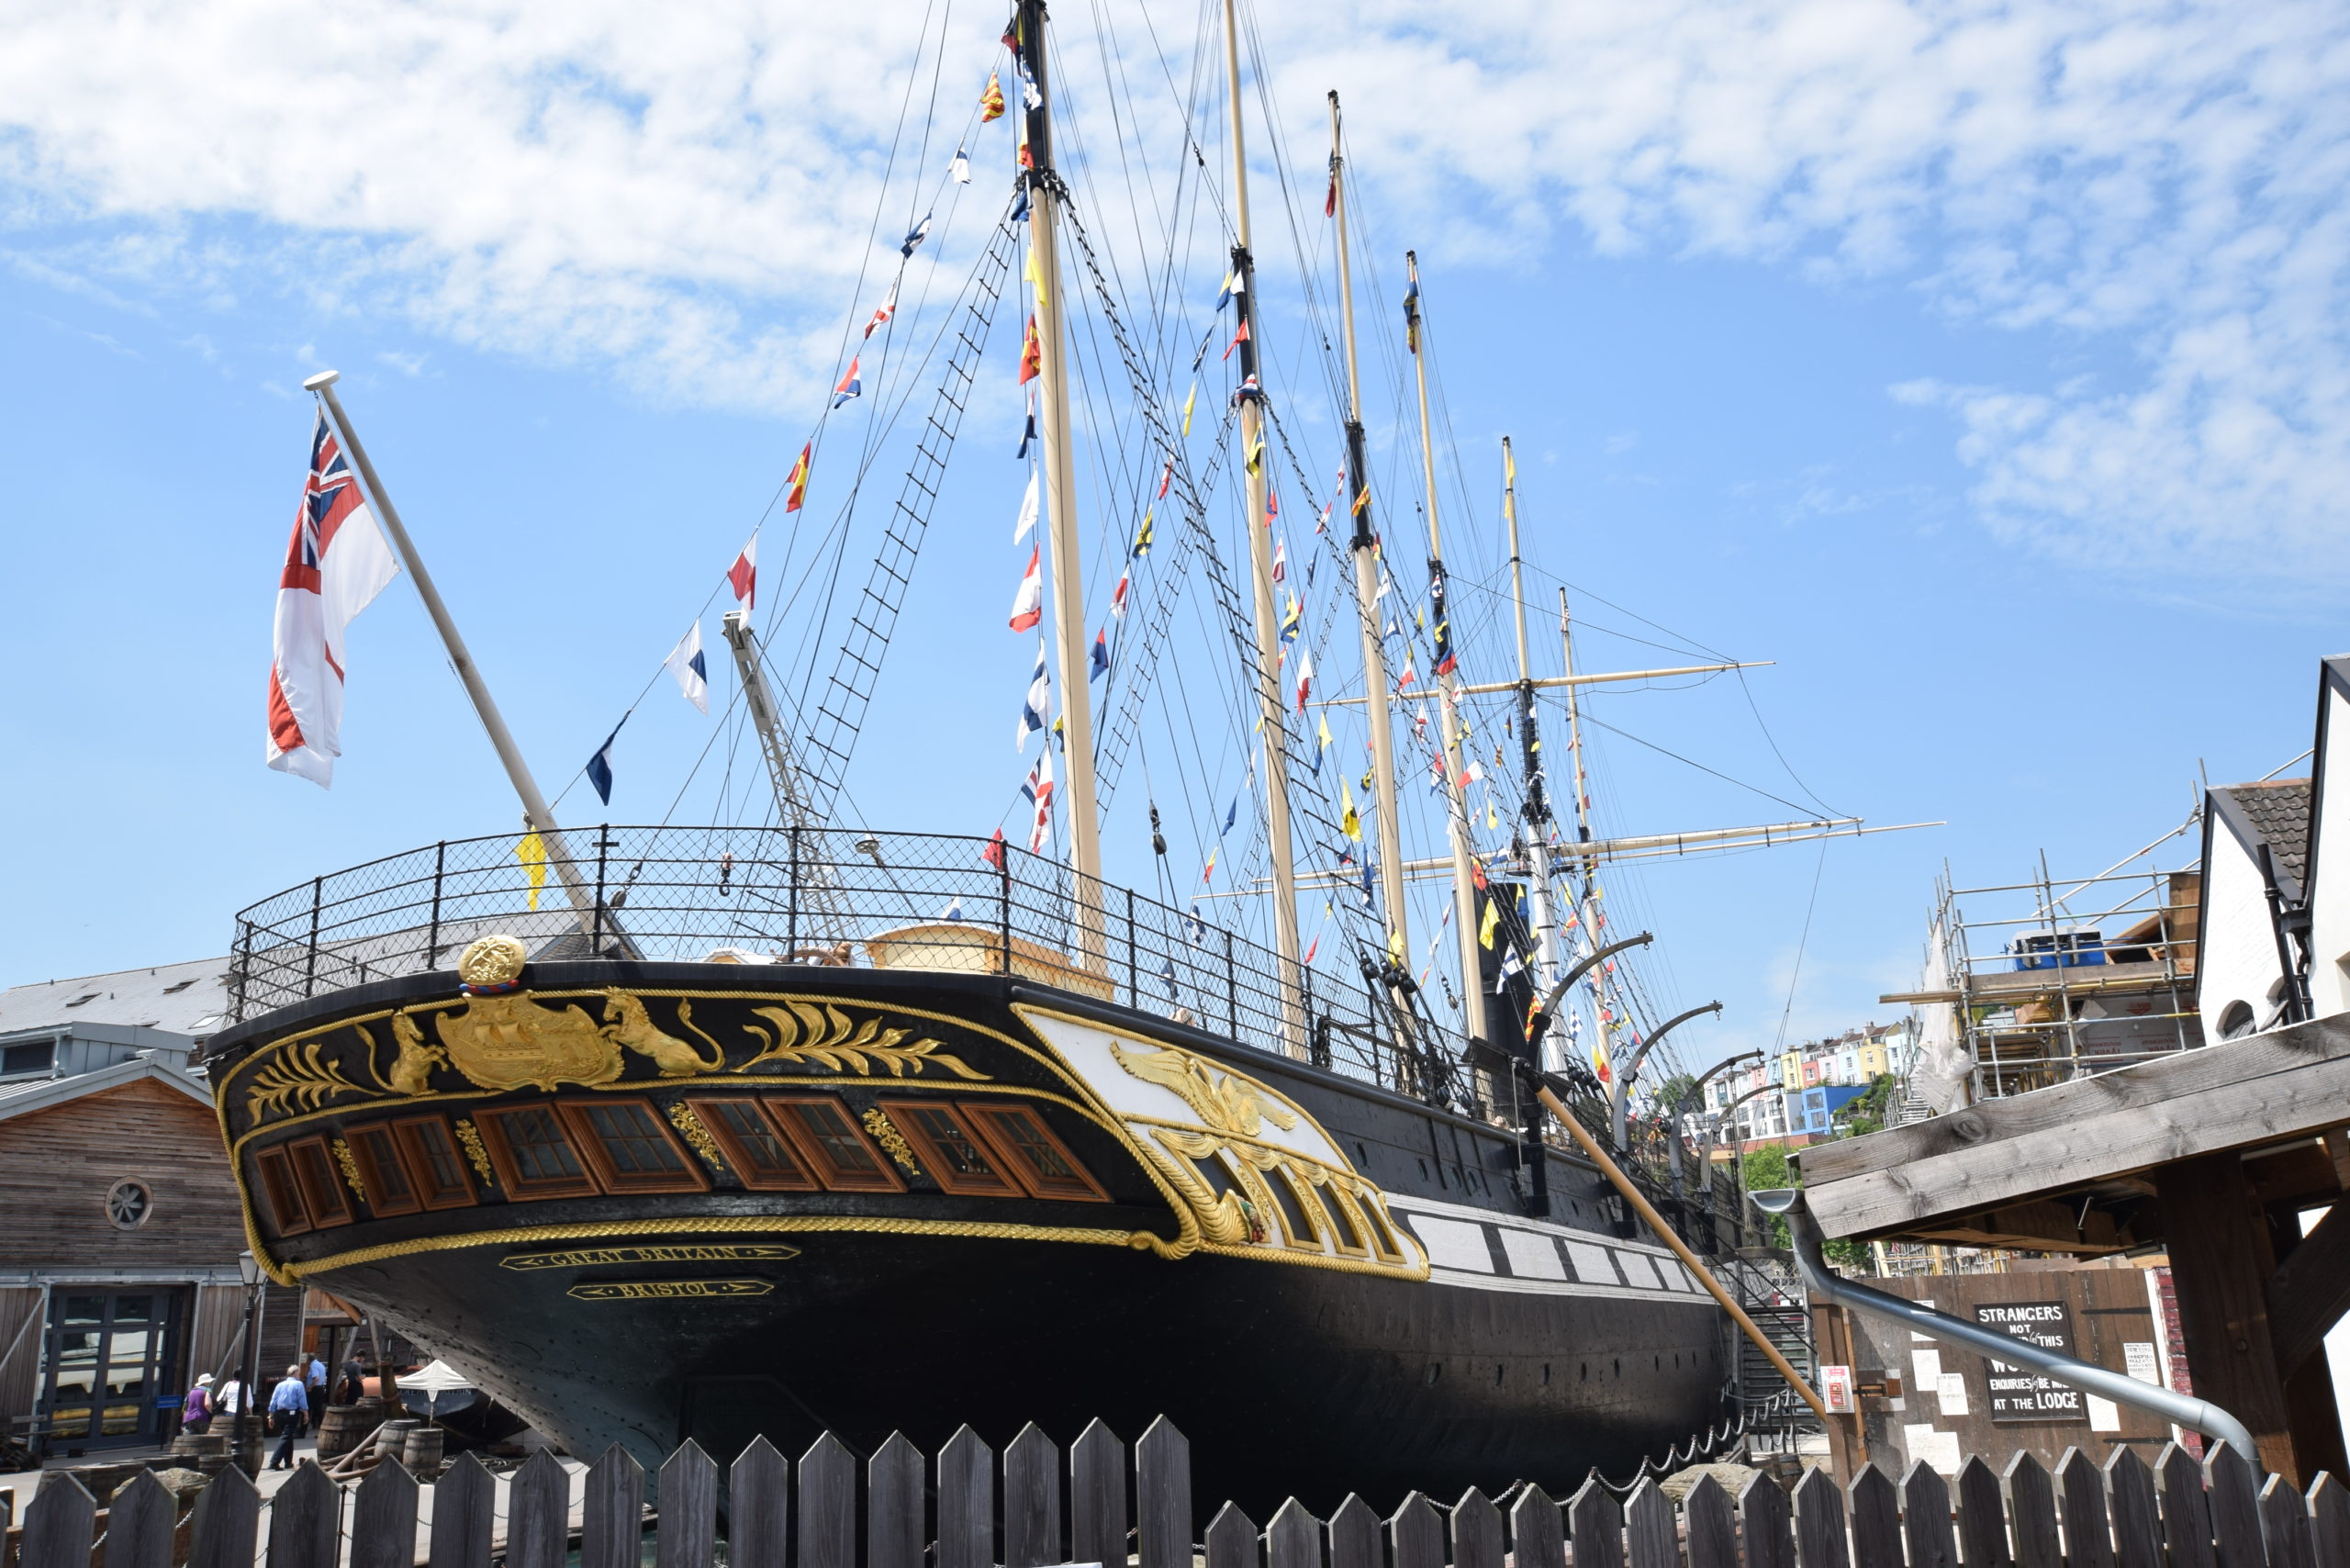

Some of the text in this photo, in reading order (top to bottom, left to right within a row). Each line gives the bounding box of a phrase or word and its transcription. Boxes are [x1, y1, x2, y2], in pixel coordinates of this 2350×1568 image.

[551, 1247, 738, 1265] GREAT BRITAIN
[618, 1283, 717, 1296] BRISTOL
[1979, 1306, 2063, 1322] STRANGERS
[2009, 1325, 2031, 1334] NOT
[2037, 1335, 2064, 1348] THIS
[1989, 1378, 2032, 1390] ENQUIRIES
[2038, 1377, 2050, 1389] BE
[1995, 1393, 2079, 1410] AT THE LODGE
